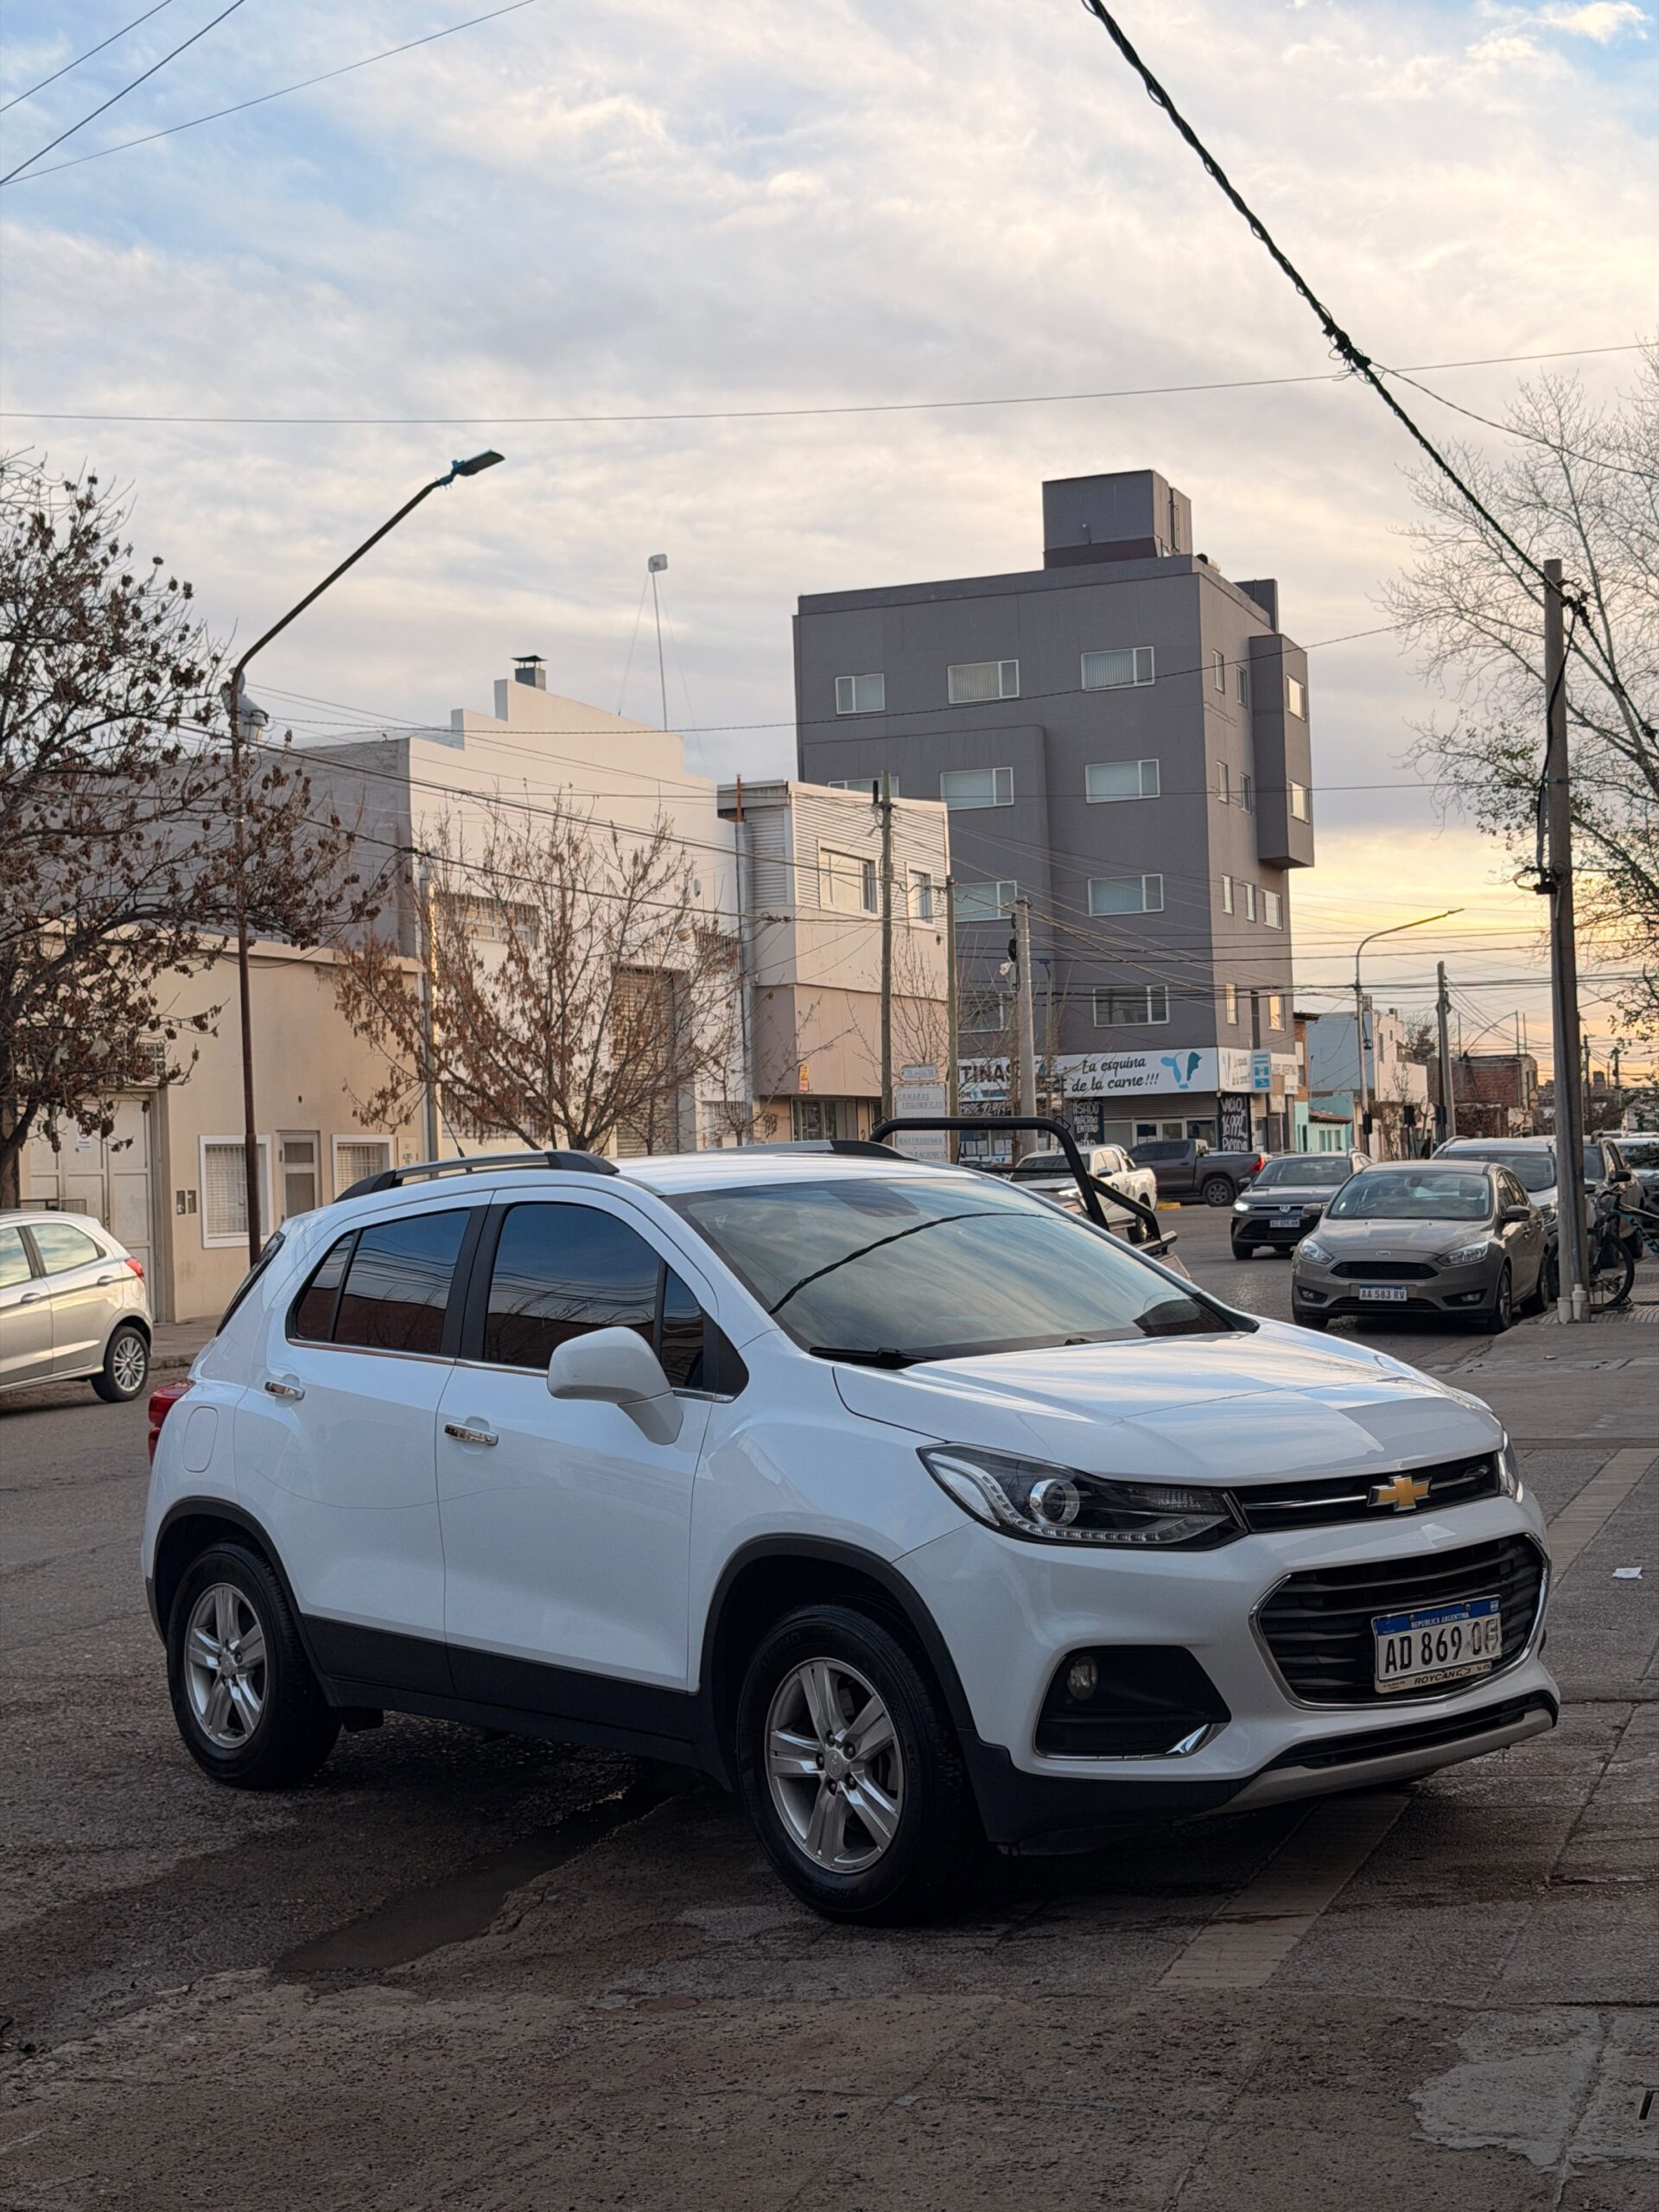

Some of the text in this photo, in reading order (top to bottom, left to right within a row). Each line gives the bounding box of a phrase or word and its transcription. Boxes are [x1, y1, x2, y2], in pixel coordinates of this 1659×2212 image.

[1082, 1057, 1147, 1077] La esquina
[1071, 1078, 1087, 1092] de
[1091, 1077, 1103, 1090] la
[1361, 1289, 1405, 1300] AA 583 RV
[1385, 1635, 1413, 1674] AD
[1421, 1625, 1462, 1666] 869
[1414, 1669, 1455, 1685] ROYCAN
